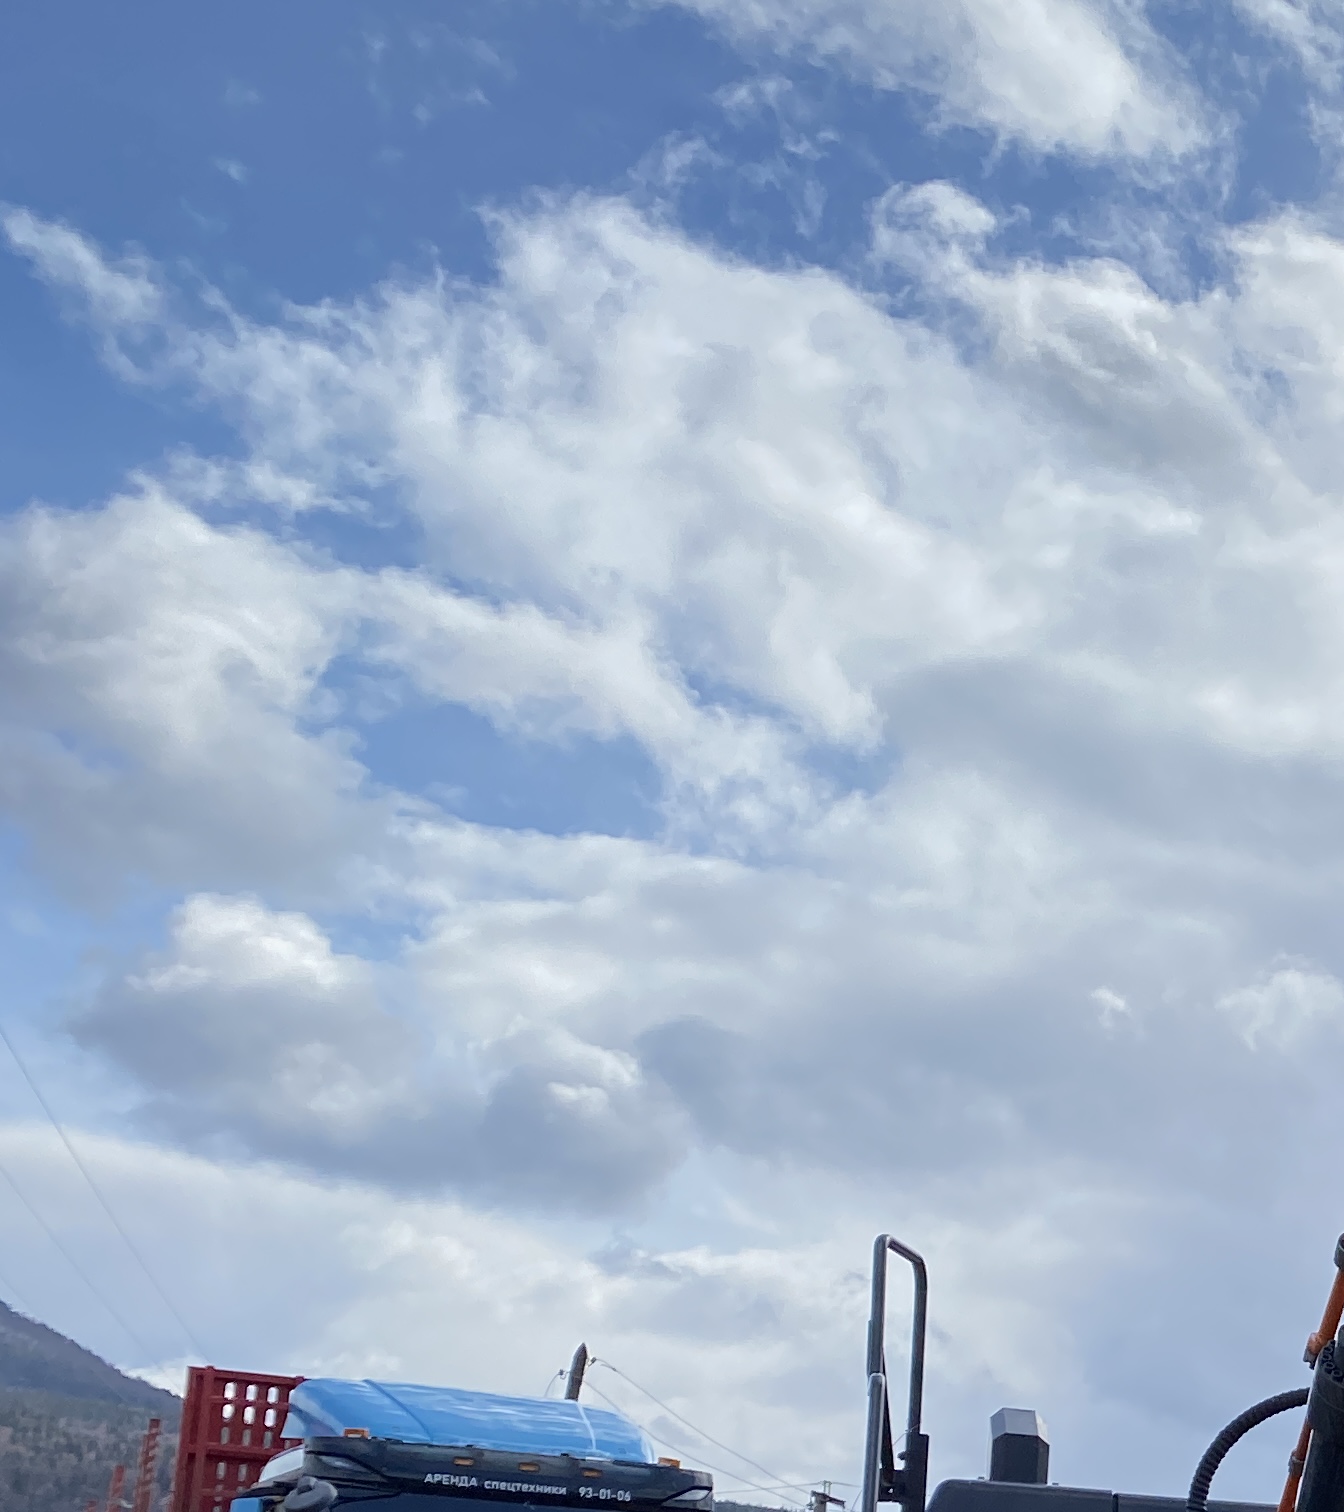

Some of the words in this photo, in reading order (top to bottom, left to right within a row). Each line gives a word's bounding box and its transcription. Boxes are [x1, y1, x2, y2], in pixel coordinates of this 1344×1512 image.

[424, 1473, 478, 1488] АРЕНДА
[483, 1479, 567, 1496] спецтехники
[578, 1486, 631, 1502] 93-01-06
